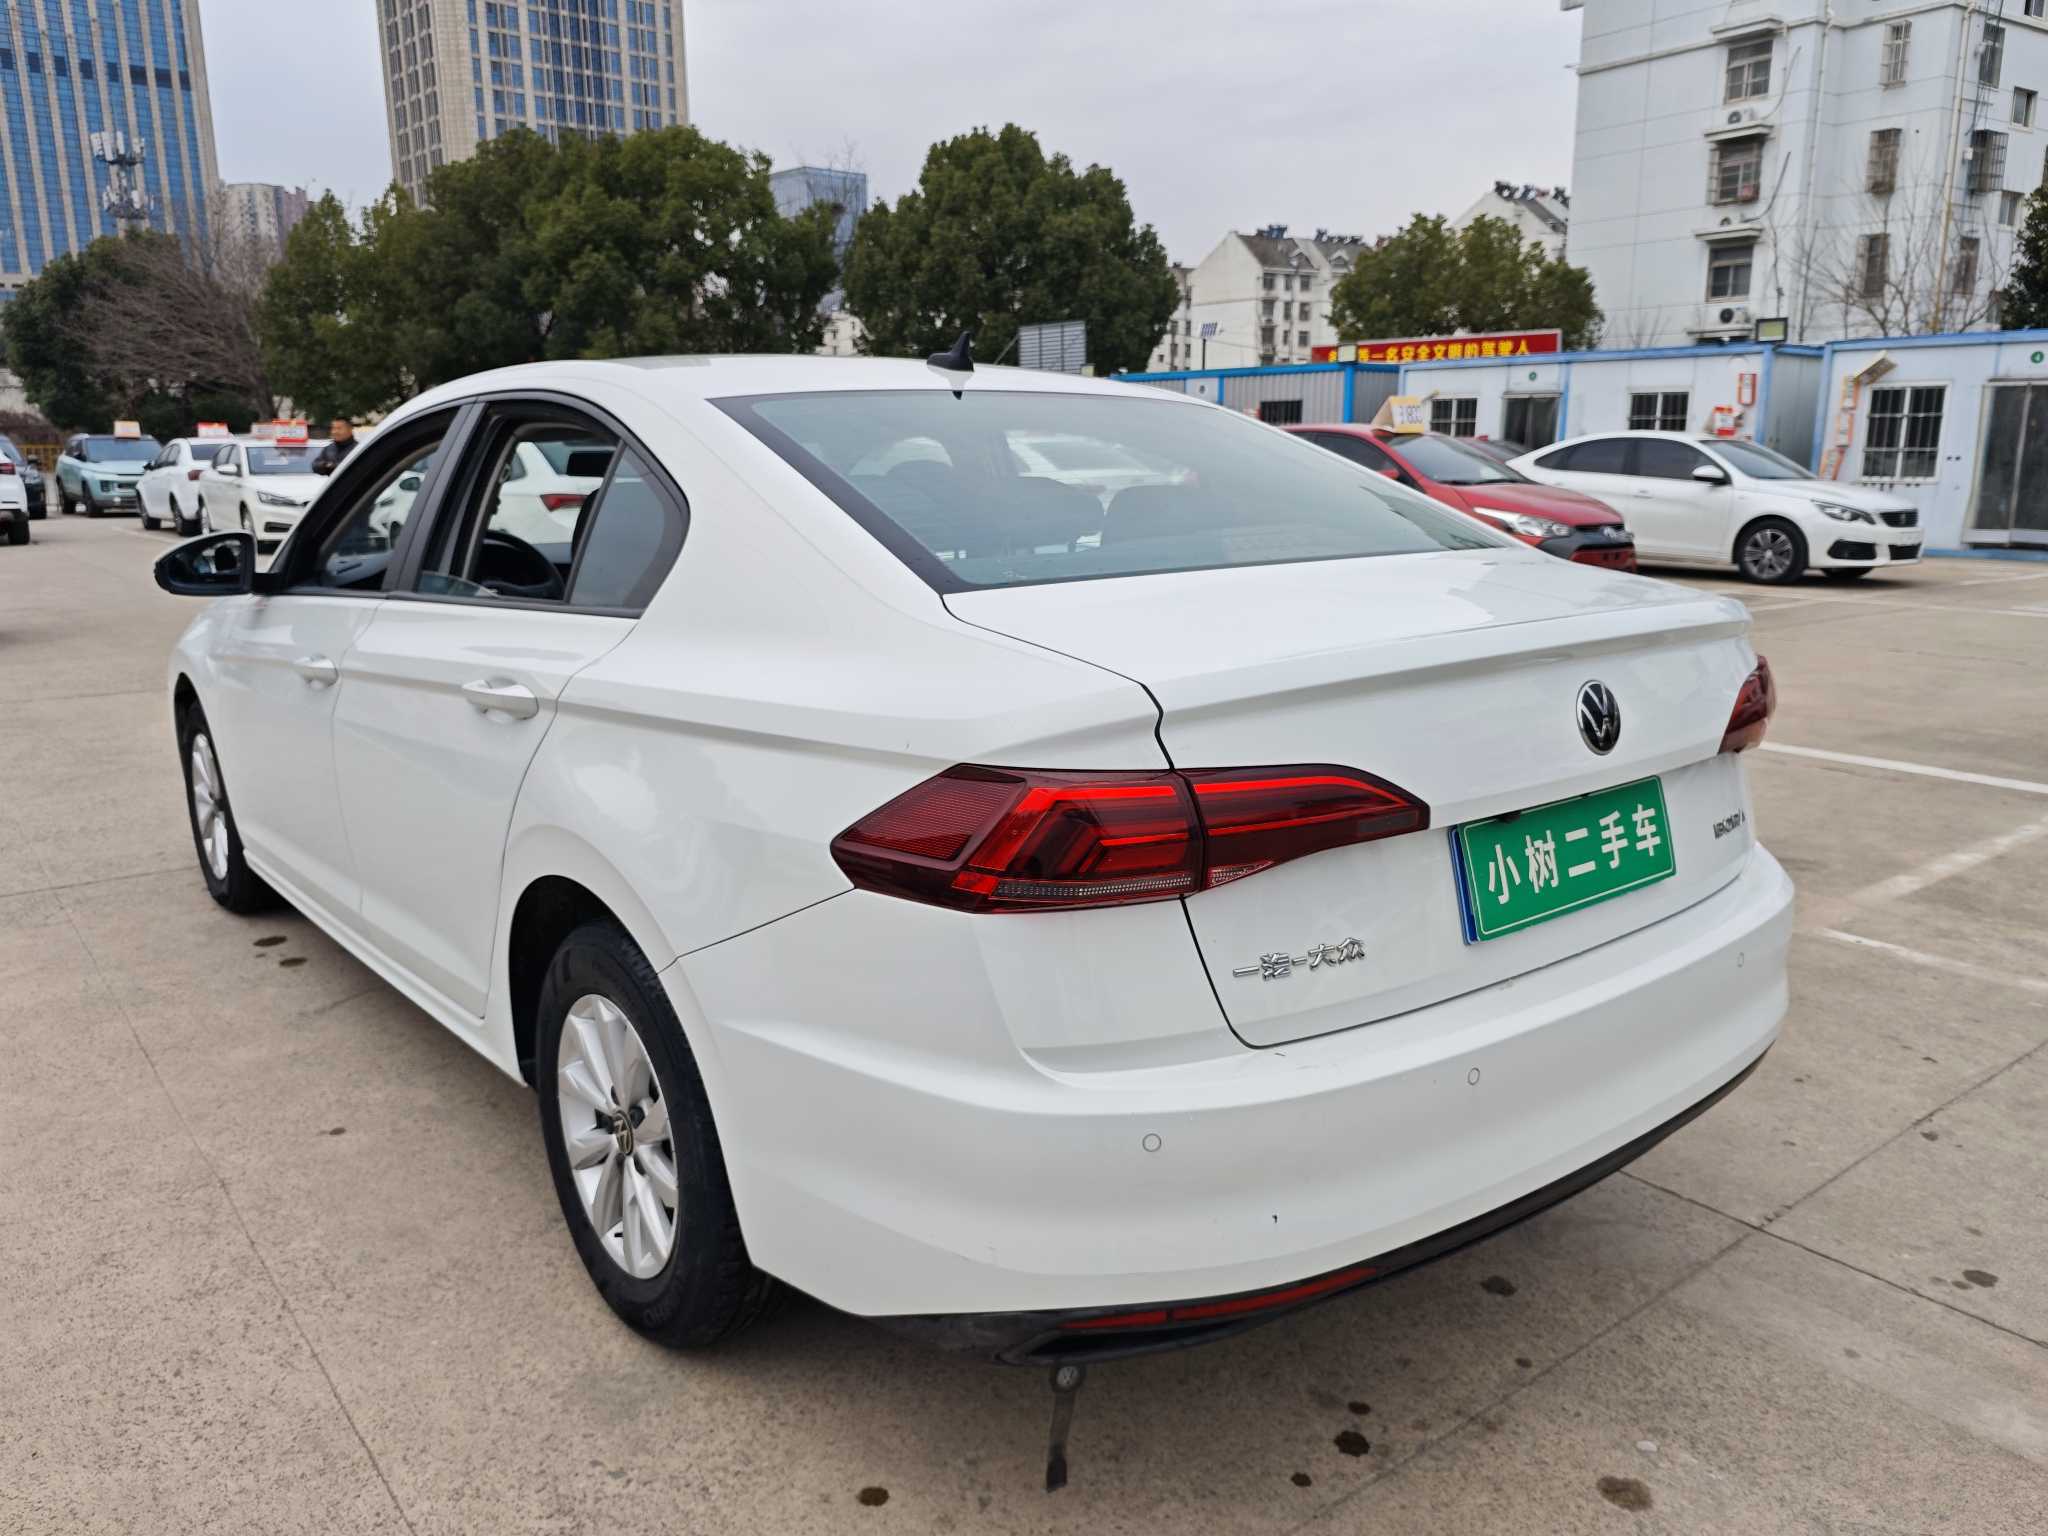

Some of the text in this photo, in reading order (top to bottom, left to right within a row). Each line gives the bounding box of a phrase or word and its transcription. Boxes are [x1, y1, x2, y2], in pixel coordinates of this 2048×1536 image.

[1487, 803, 1662, 905] 小树二手车
[1232, 937, 1366, 982] 一汽-大众
